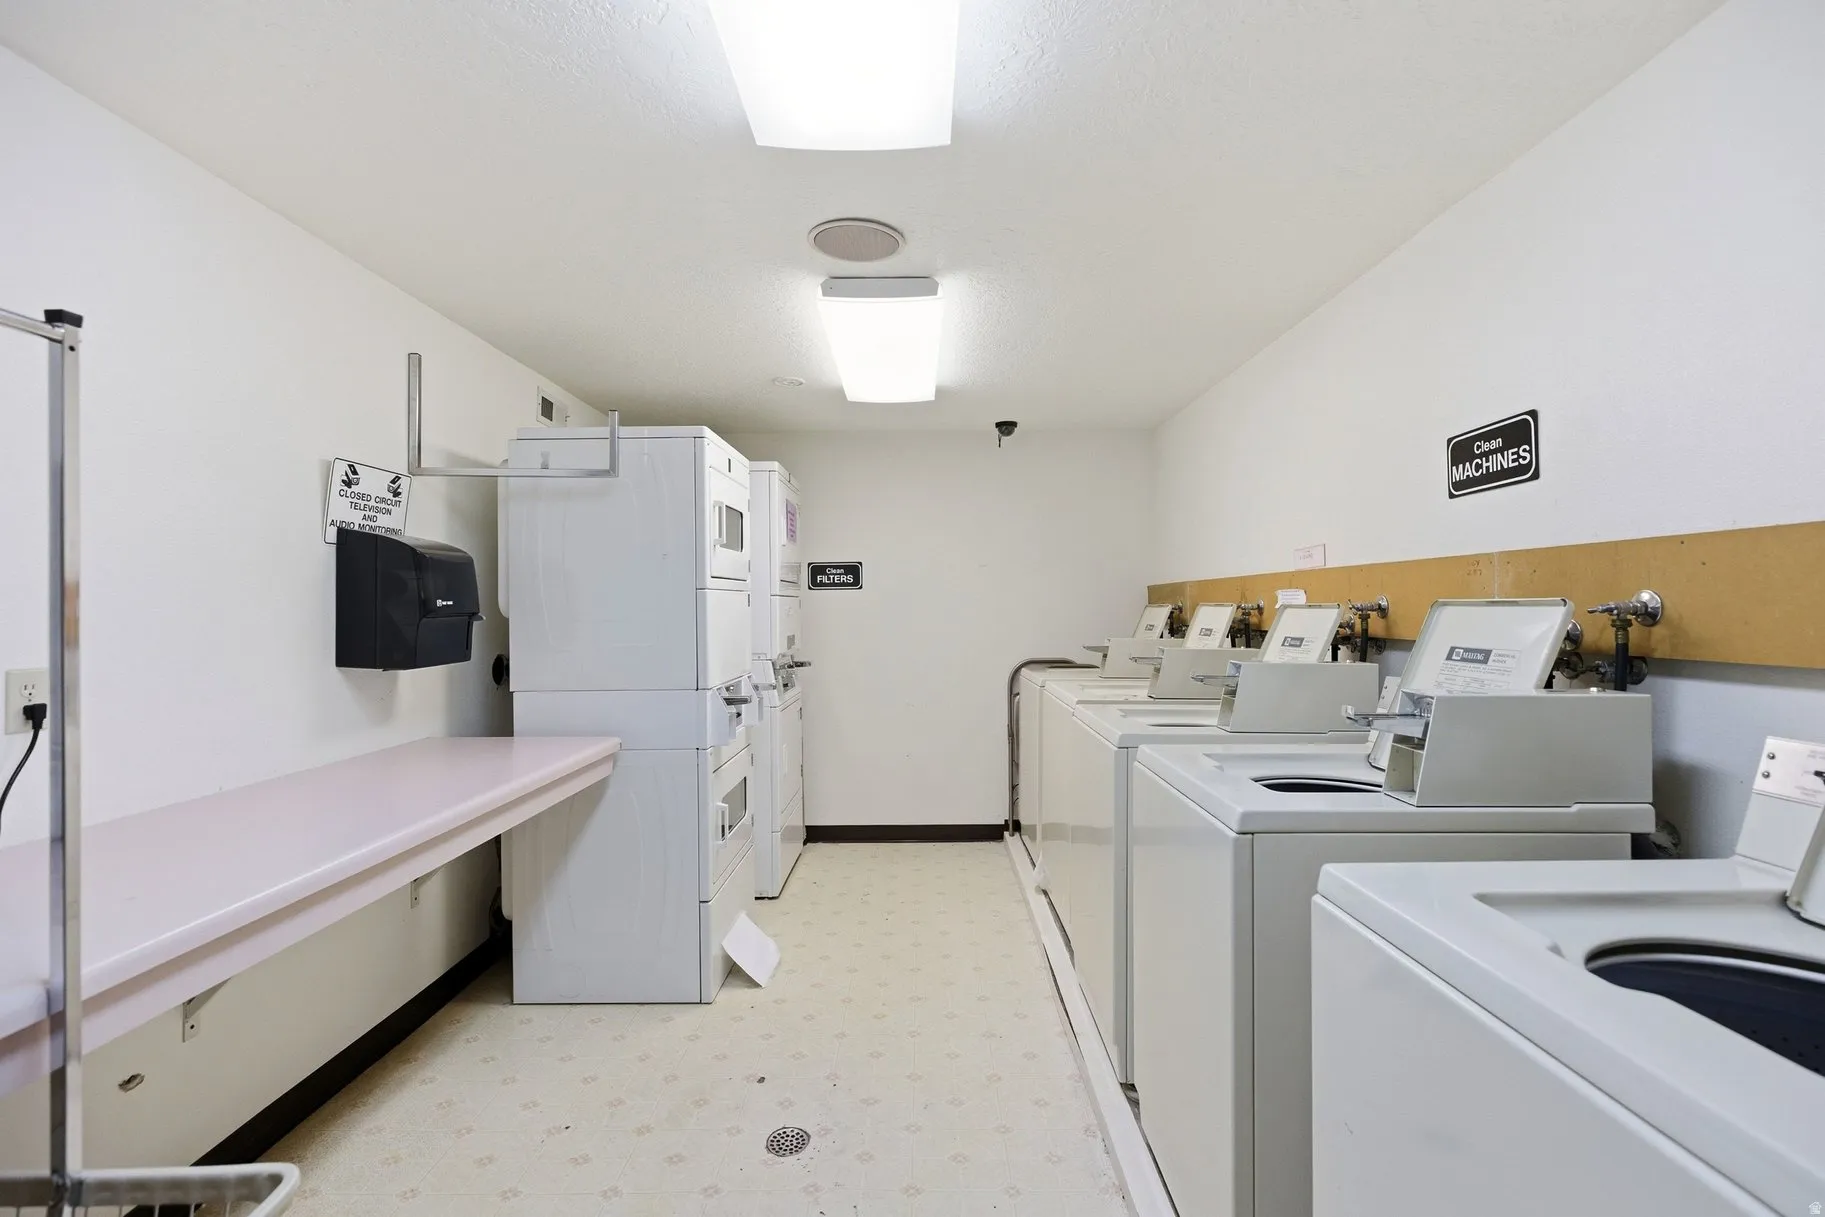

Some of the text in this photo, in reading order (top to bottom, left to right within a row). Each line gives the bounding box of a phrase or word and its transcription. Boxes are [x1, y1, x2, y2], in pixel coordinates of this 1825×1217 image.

[1473, 438, 1503, 454] Clean
[1452, 444, 1531, 483] MACHINES
[338, 488, 402, 508] CLOSED CIRCUIT
[349, 501, 392, 516] TELEVISION
[361, 513, 378, 523] AND
[329, 519, 403, 536] AUDIO MONITORING
[817, 574, 854, 583] FILTERS
[1463, 651, 1485, 660] MAYTAG
